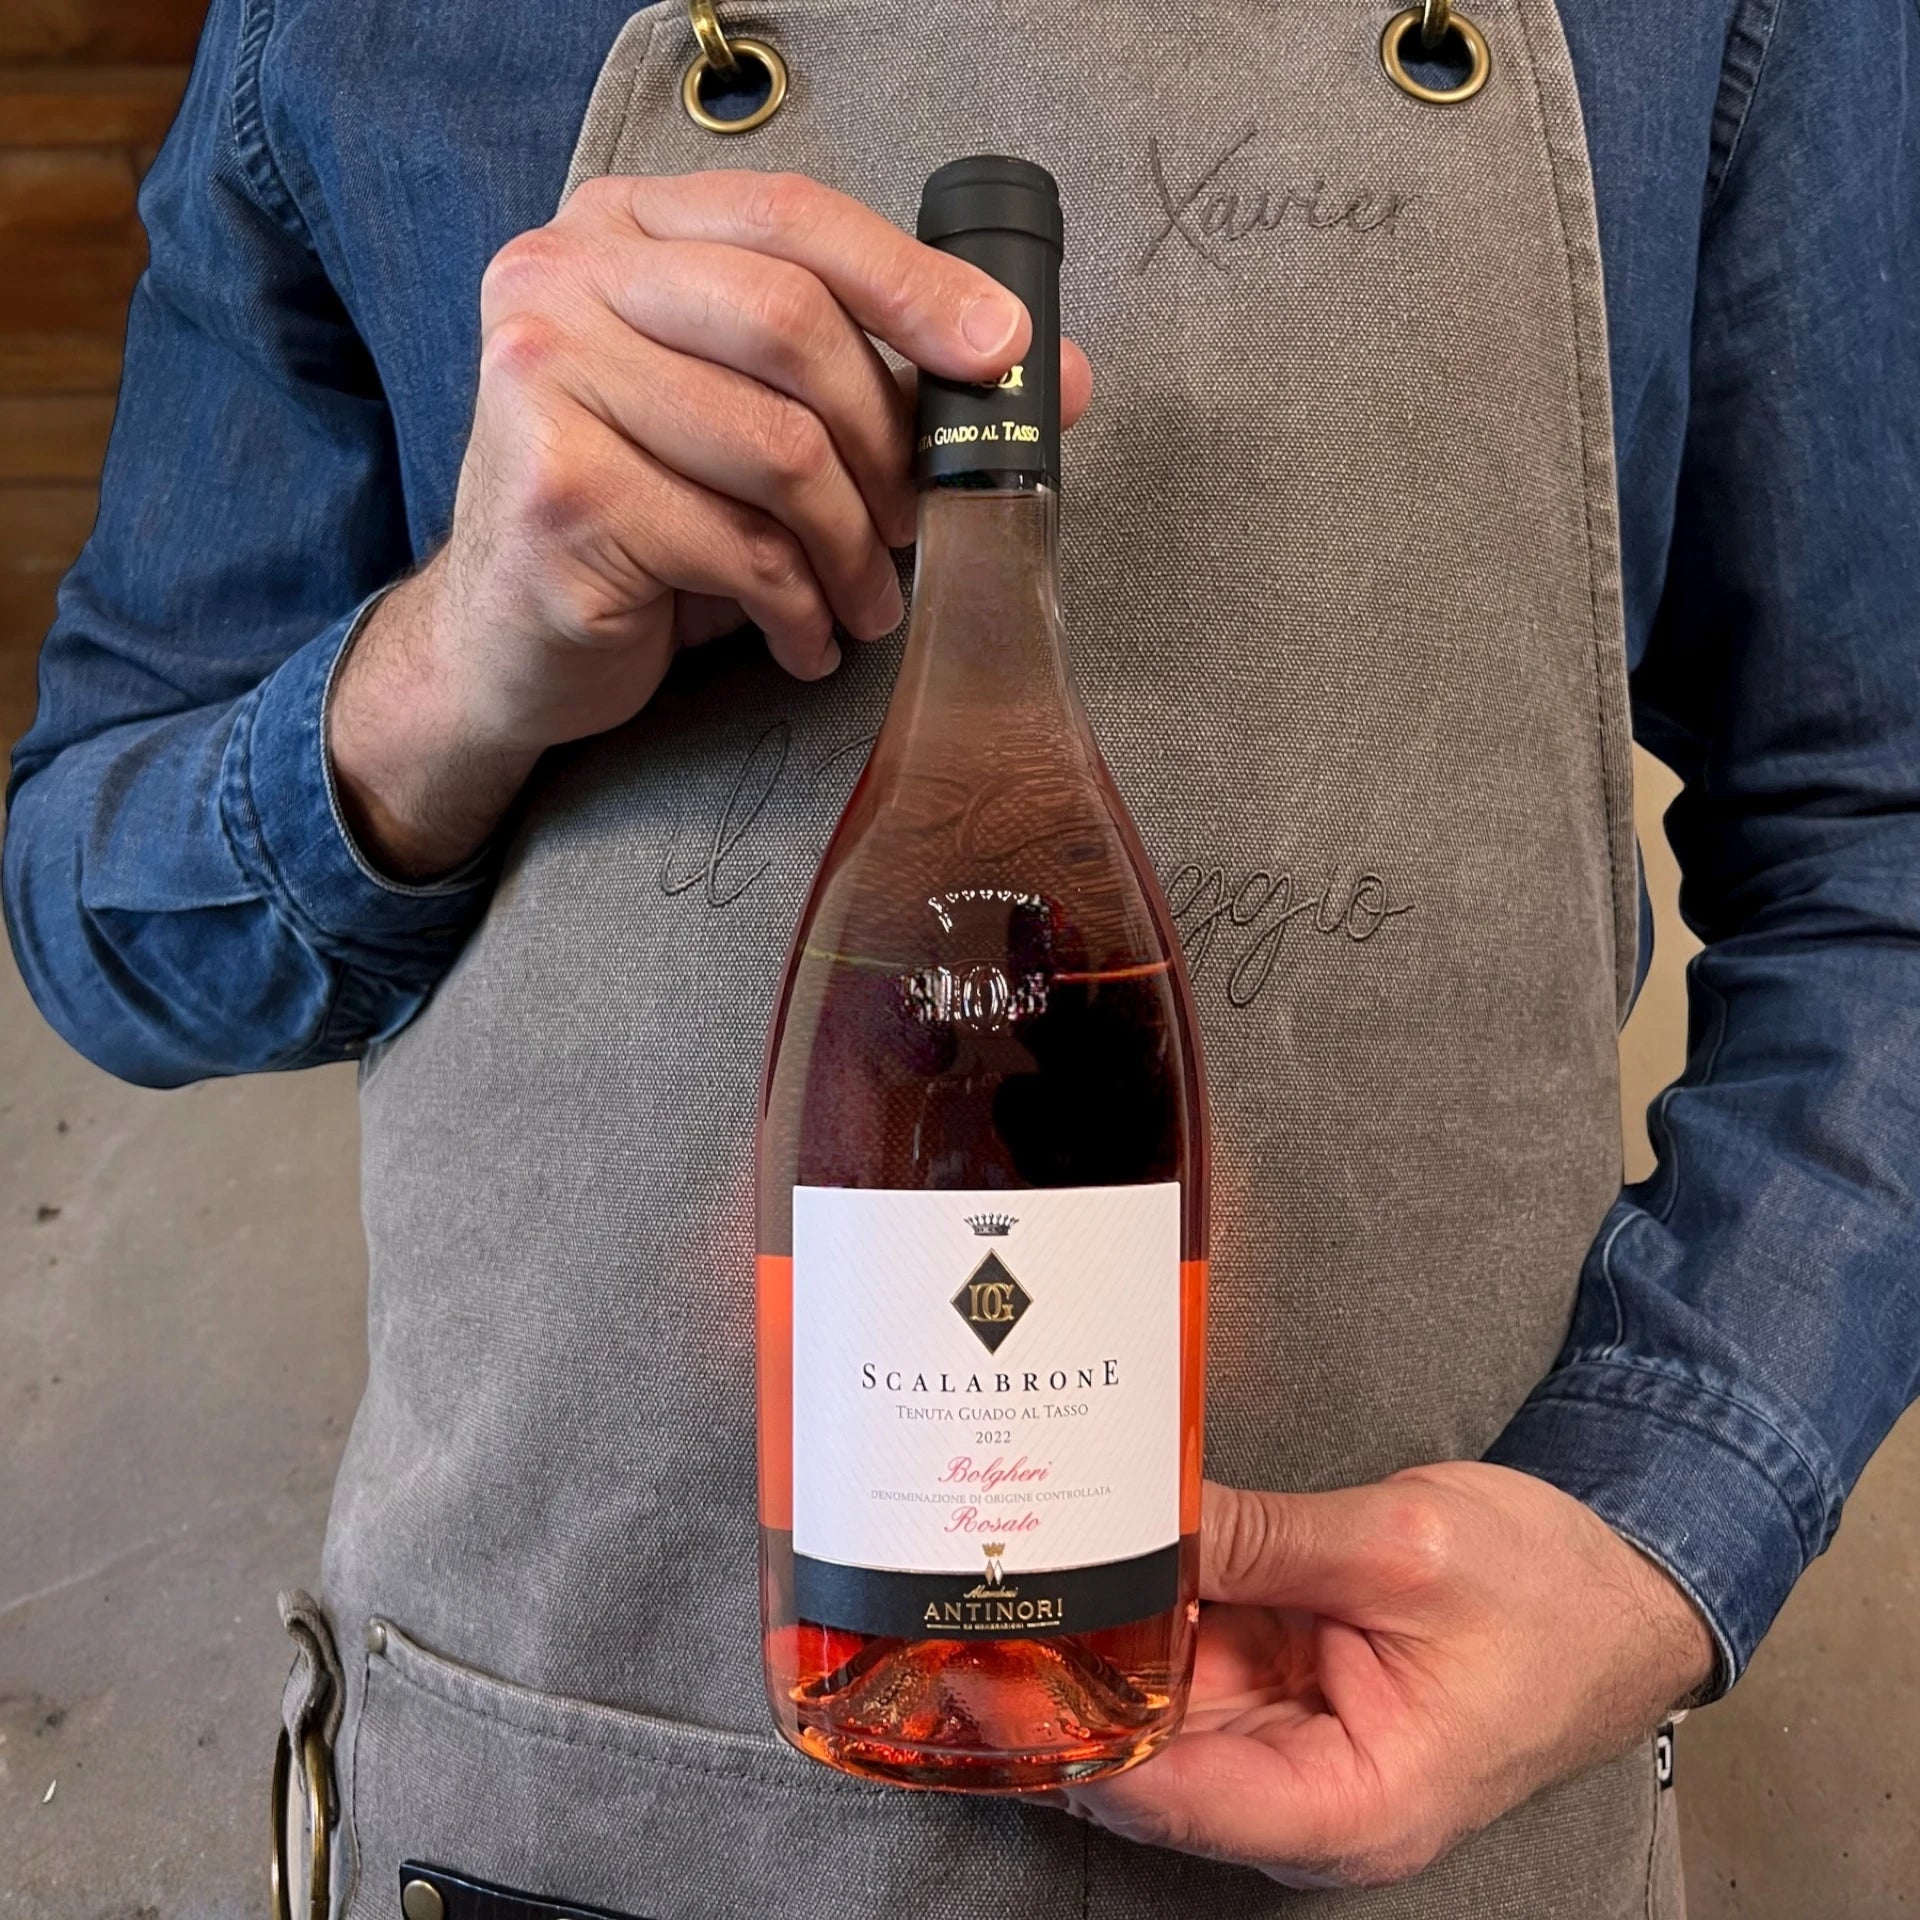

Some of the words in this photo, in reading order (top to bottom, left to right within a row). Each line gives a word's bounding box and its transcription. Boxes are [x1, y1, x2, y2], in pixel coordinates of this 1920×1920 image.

[1136, 128, 1424, 275] Xavier
[934, 425, 978, 445] GUADO
[981, 425, 999, 441] AL
[1002, 421, 1040, 442] TASSO
[862, 1358, 1120, 1394] SCALABRONE
[896, 1404, 954, 1421] TENUTA
[958, 1406, 1017, 1421] GUADO
[1021, 1406, 1041, 1420] AL
[1044, 1402, 1090, 1419] TASSO
[975, 1430, 1012, 1444] 2022
[937, 1455, 1053, 1493] Bolgheri
[870, 1489, 967, 1505] DENOMINAZIONE
[969, 1493, 983, 1505] DI
[985, 1492, 1034, 1505] ORIGINE
[1035, 1484, 1112, 1502] CONTROLLATA
[943, 1505, 1042, 1533] Rosato
[923, 1597, 1064, 1622] ANTINORI
